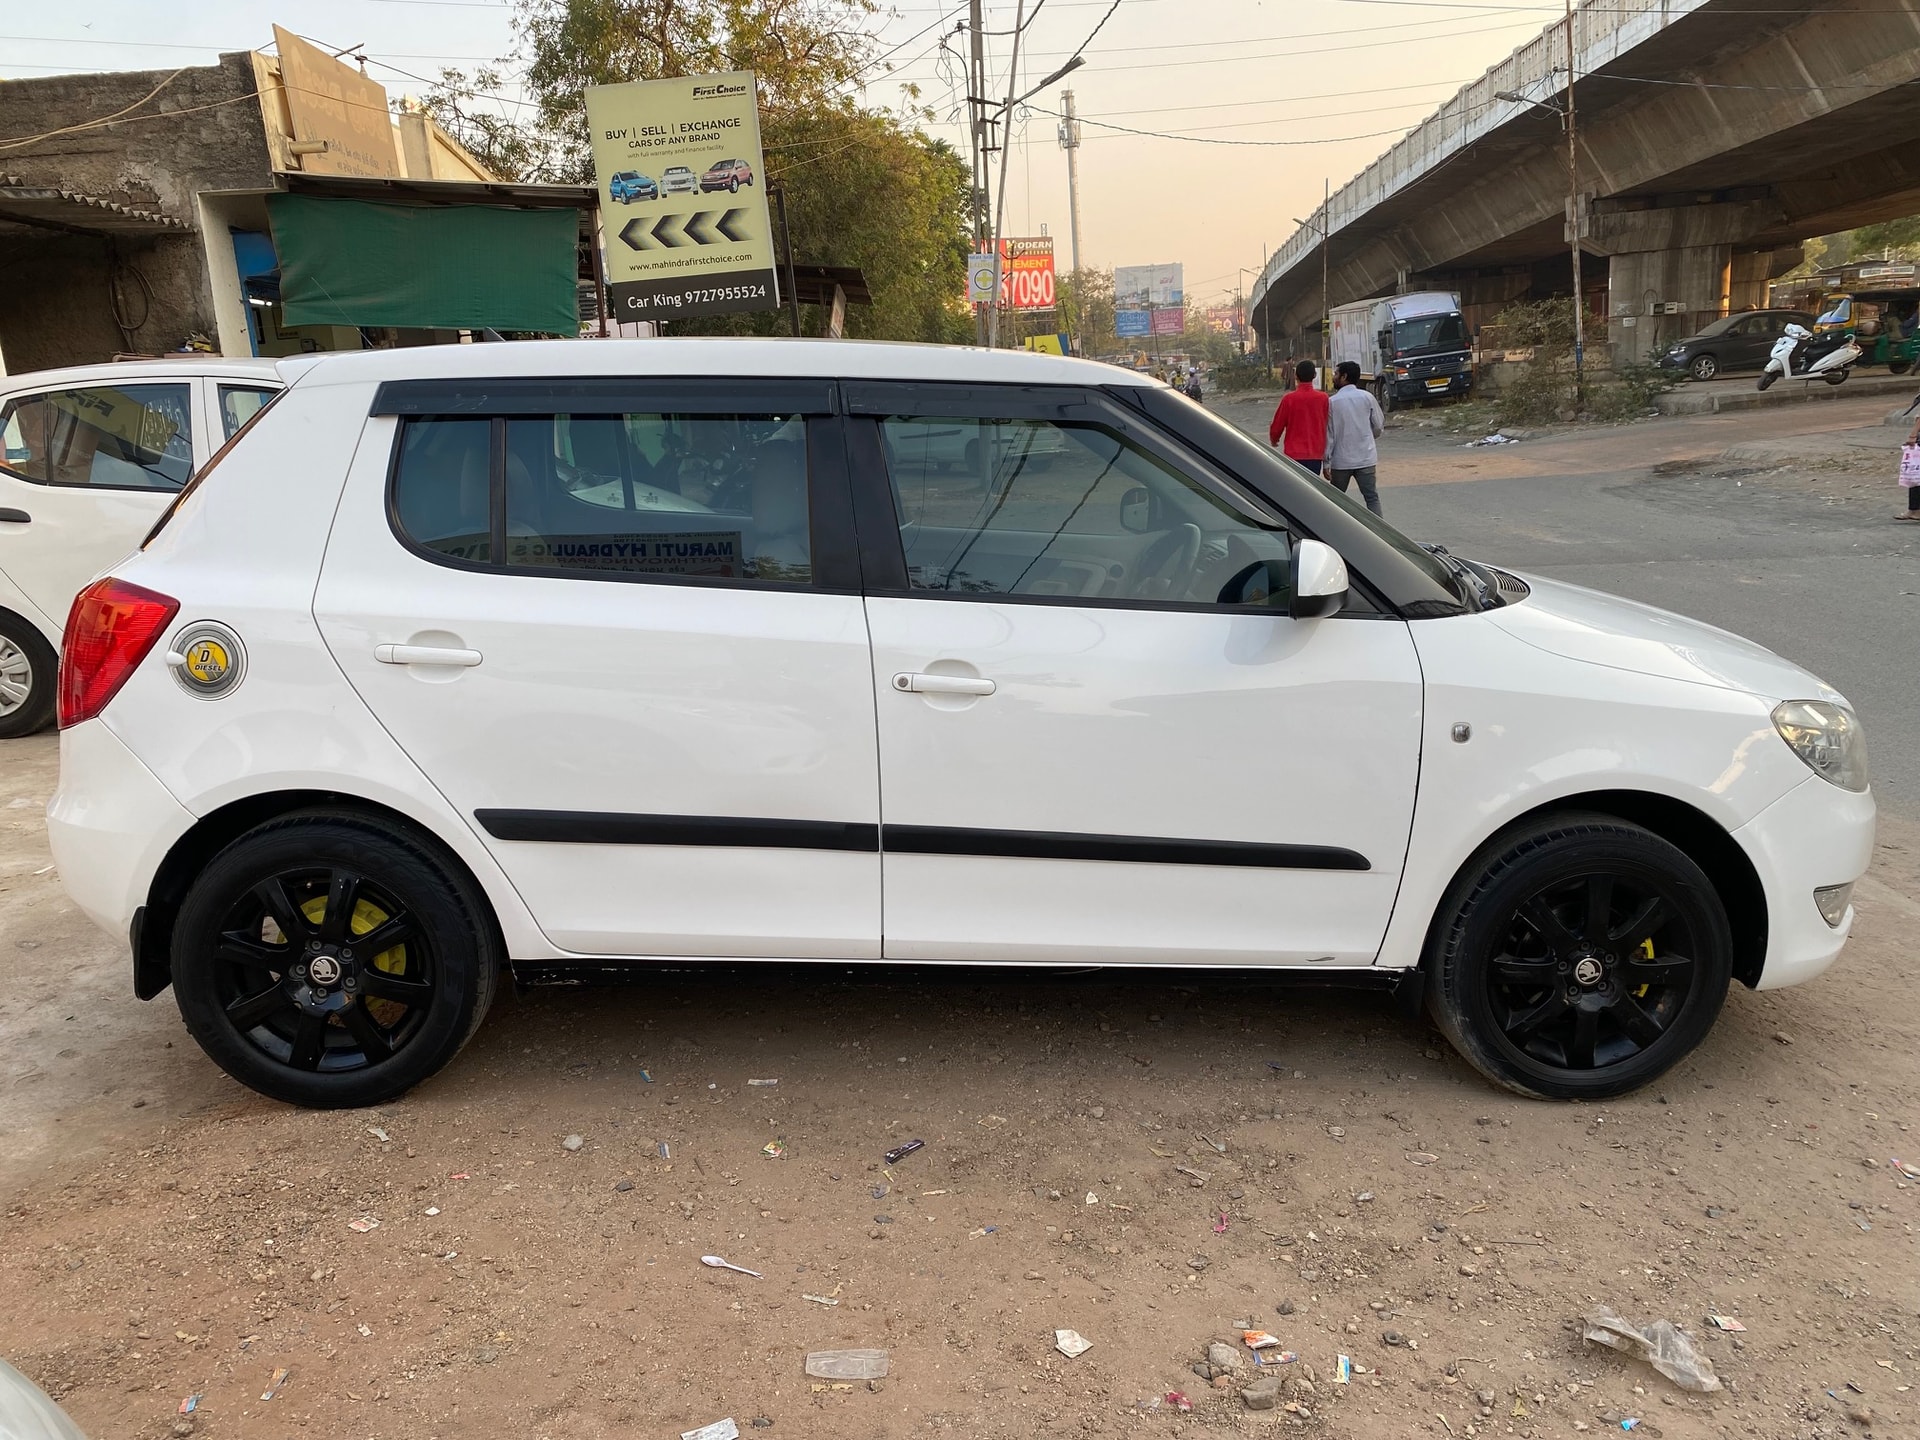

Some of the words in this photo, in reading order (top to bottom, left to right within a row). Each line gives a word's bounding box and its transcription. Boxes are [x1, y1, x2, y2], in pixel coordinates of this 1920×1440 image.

[605, 129, 628, 140] BUY
[641, 125, 667, 137] SELL
[680, 117, 741, 133] EXCHANGE
[628, 139, 653, 149] CARS
[654, 138, 667, 146] OF
[668, 135, 687, 145] ANY
[689, 132, 720, 143] BRAND
[650, 149, 673, 157] warranty
[685, 145, 706, 153] finance
[628, 253, 753, 272] www.mahindrafirstchoice.com
[627, 295, 649, 309] Car
[653, 293, 682, 308] King
[684, 284, 766, 304] 9727955524
[200, 649, 210, 663] D
